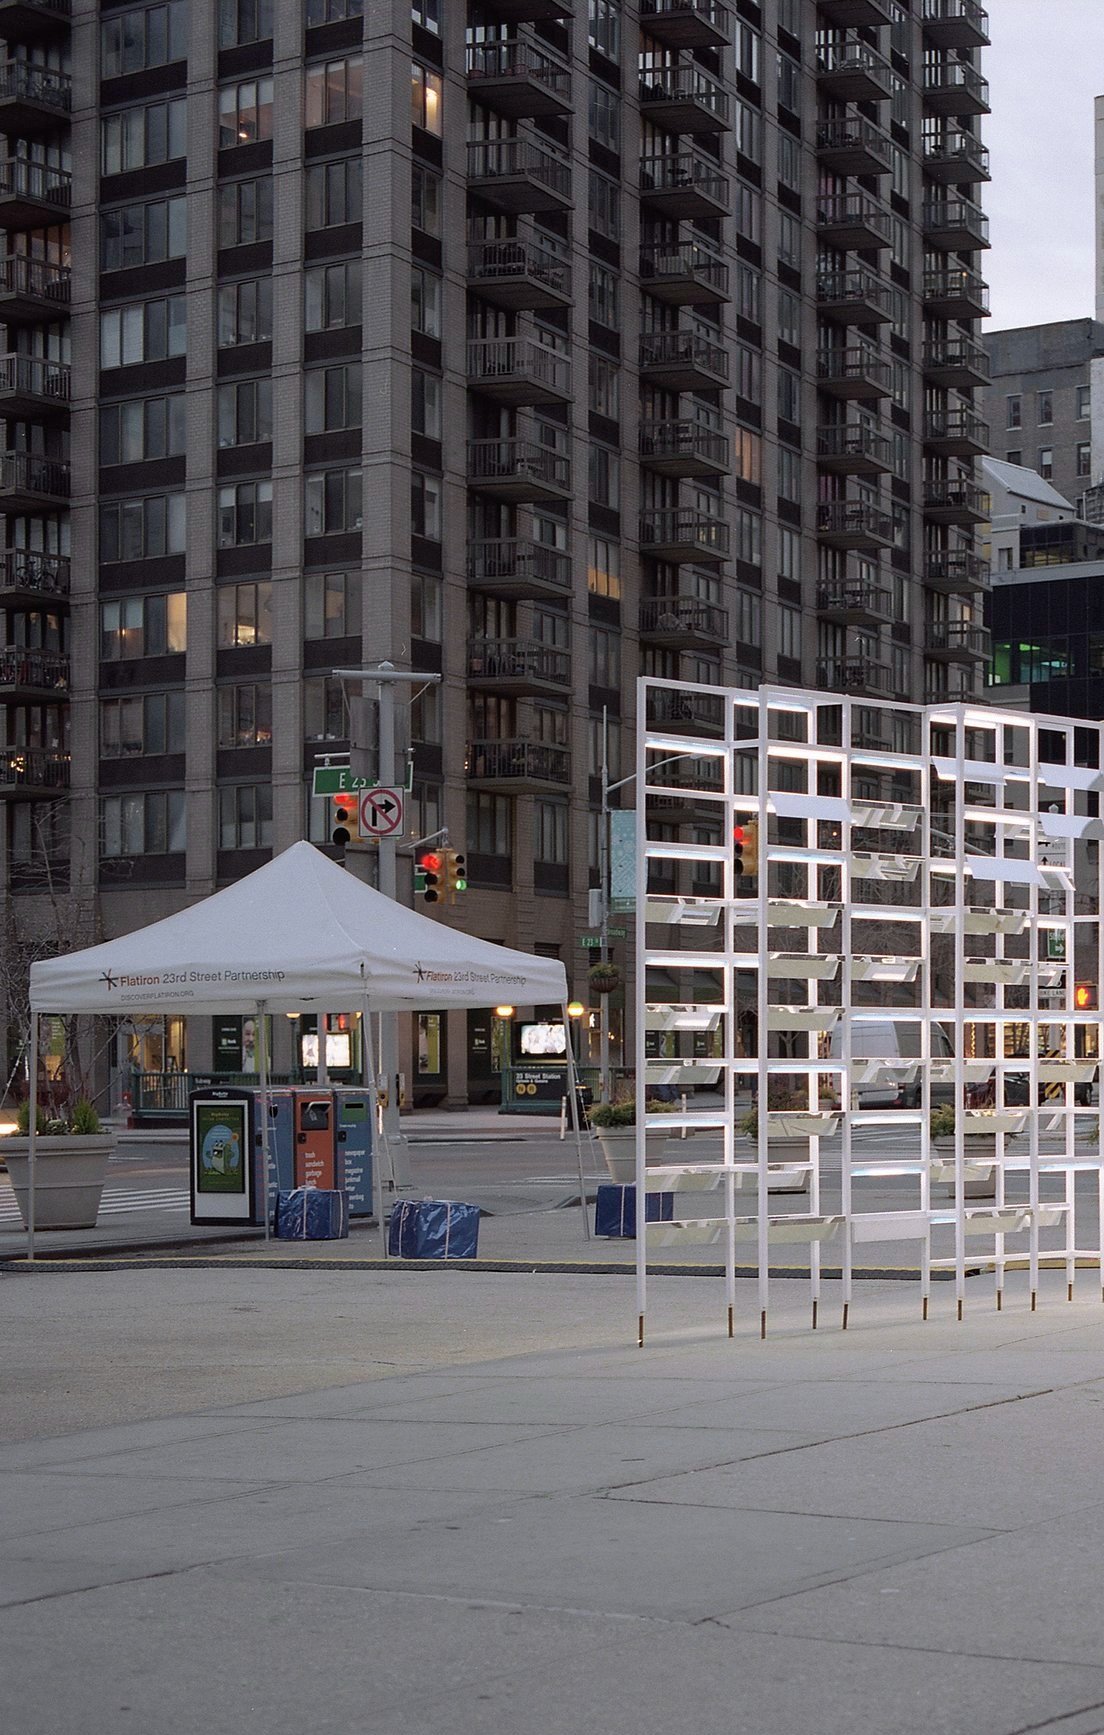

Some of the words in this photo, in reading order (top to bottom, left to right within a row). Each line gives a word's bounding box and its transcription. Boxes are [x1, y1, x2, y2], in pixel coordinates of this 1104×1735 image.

[339, 773, 346, 789] E
[120, 976, 160, 988] Flatiron
[162, 971, 187, 985] 23rd
[189, 970, 222, 983] Street
[224, 969, 286, 982] Partnership
[426, 970, 453, 982] Flatiron
[453, 971, 469, 982] 23rd
[470, 971, 490, 983] Street
[490, 973, 527, 987] Partnership
[120, 990, 195, 1001] DISCOVERFLATIRON.ORG
[515, 1072, 523, 1080] 23
[525, 1072, 541, 1080] Street
[542, 1072, 561, 1080] Station
